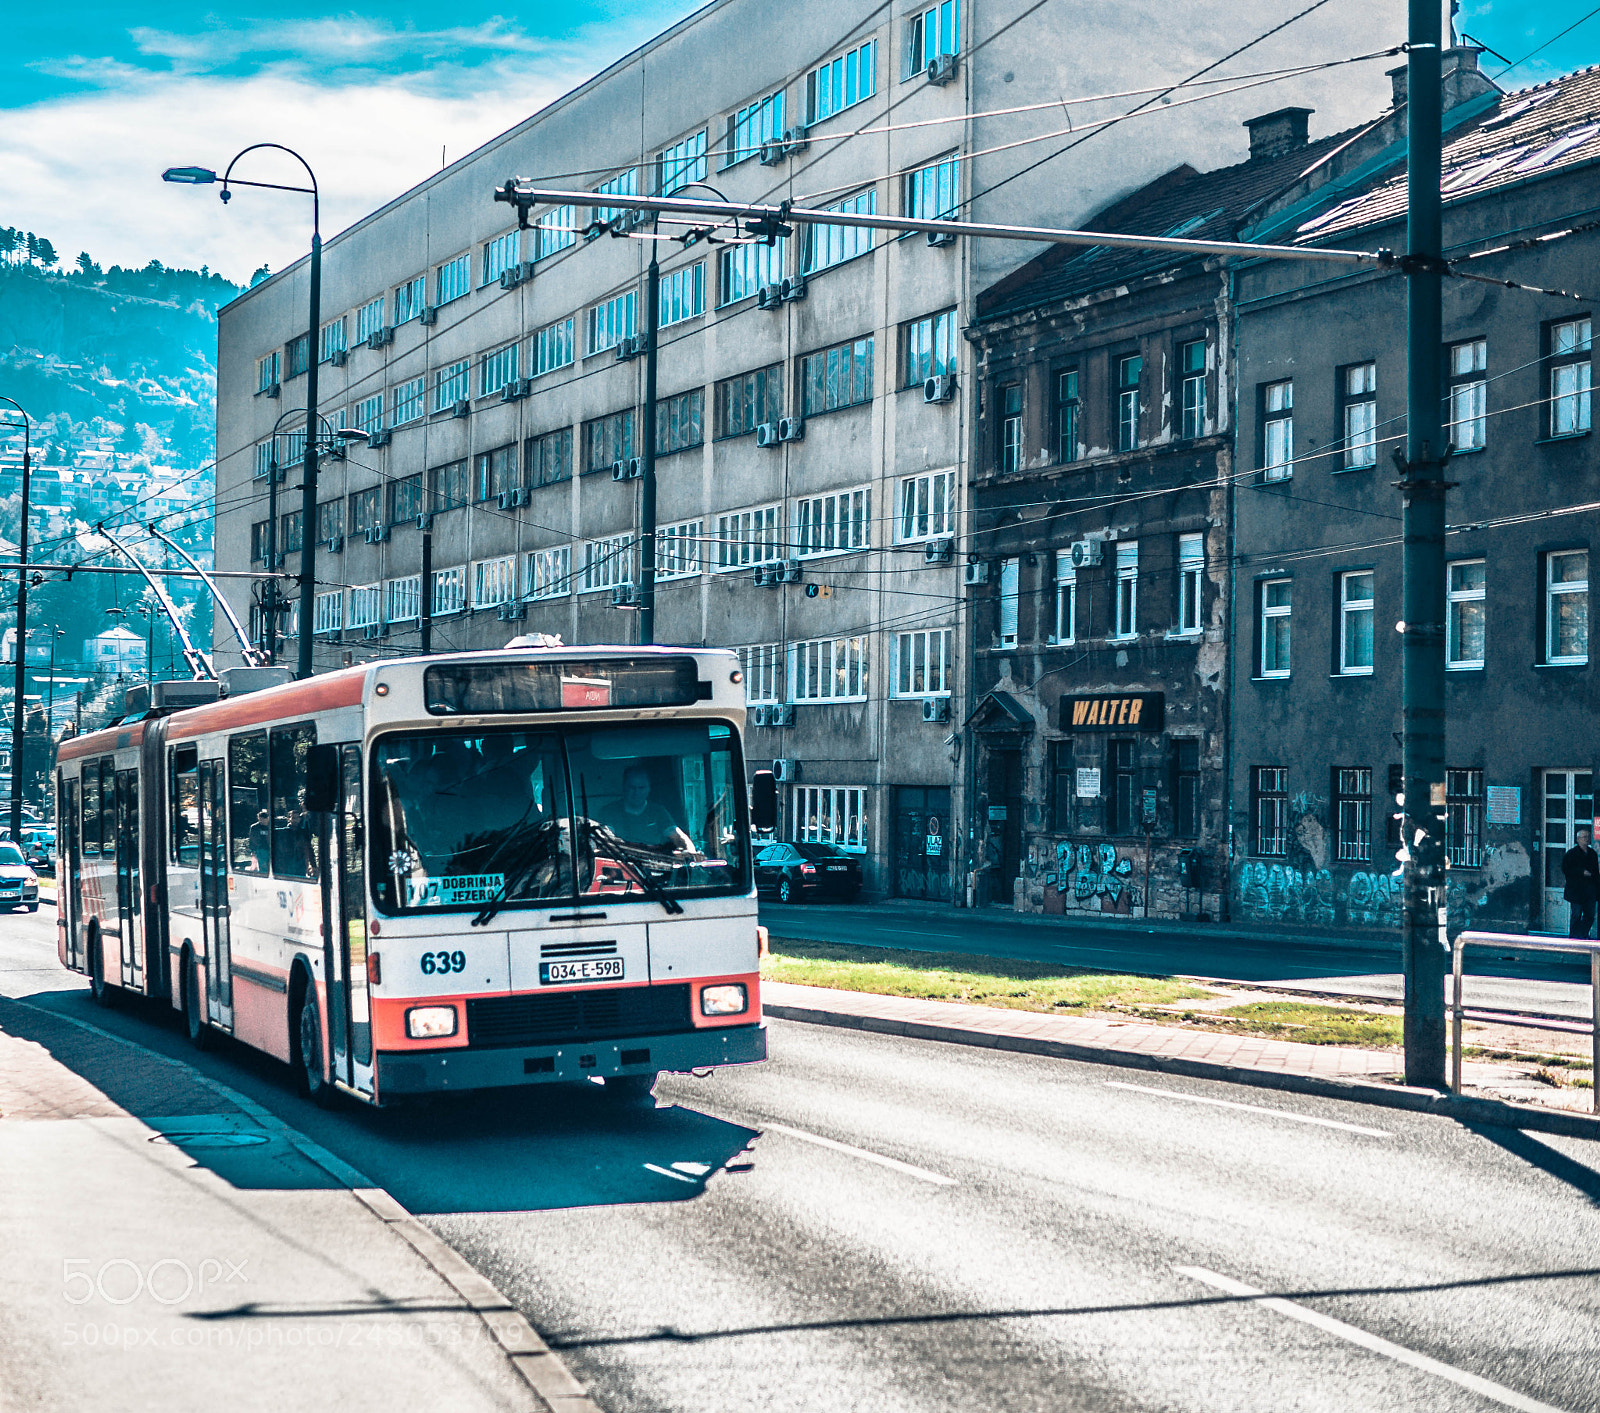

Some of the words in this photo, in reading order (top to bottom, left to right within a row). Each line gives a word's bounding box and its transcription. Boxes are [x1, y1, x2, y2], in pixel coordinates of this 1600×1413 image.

[808, 585, 816, 596] K
[1072, 698, 1143, 726] WALTER
[442, 875, 502, 890] DOBRINJA
[451, 889, 495, 903] JEZERO
[420, 950, 466, 975] 639
[551, 960, 621, 979] 034-E-598
